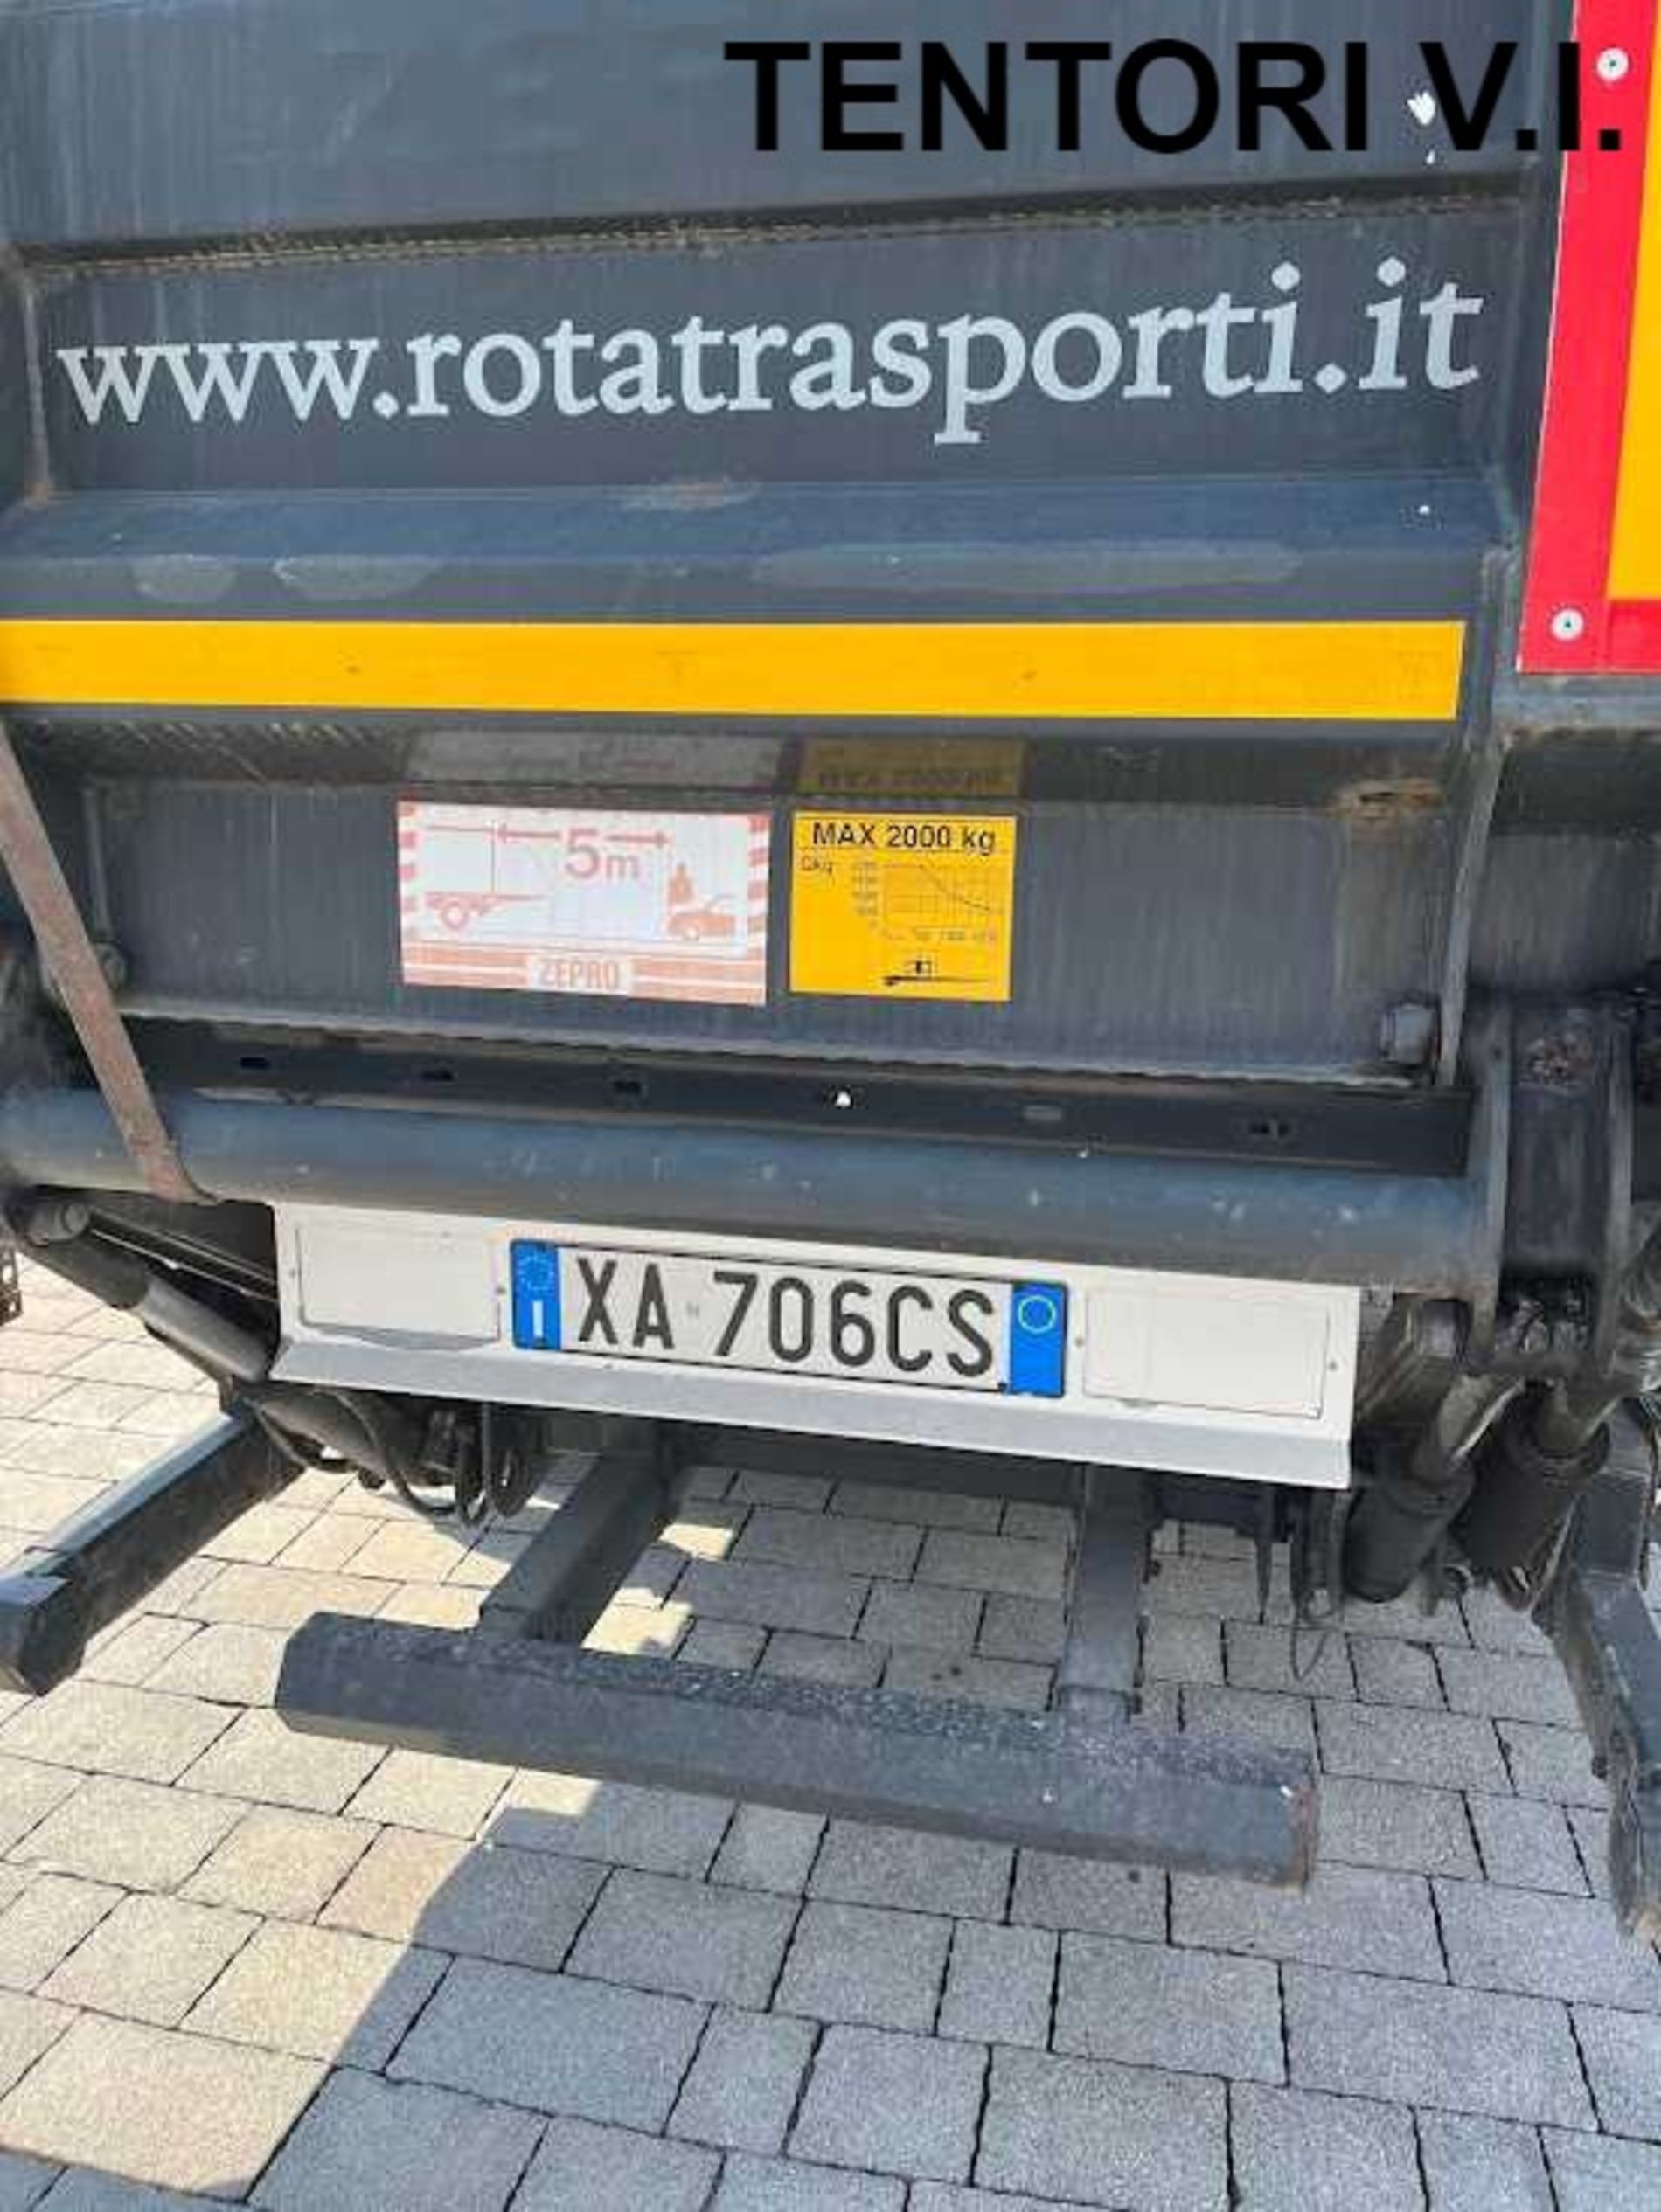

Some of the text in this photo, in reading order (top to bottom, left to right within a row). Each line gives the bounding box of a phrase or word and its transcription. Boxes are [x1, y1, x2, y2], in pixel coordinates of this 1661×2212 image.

[57, 257, 1484, 445] www.rotatrasporti.it
[812, 822, 997, 856] MAX 2000 kg
[539, 956, 620, 989] ZEPRO
[577, 1257, 995, 1378] XA 706CS
